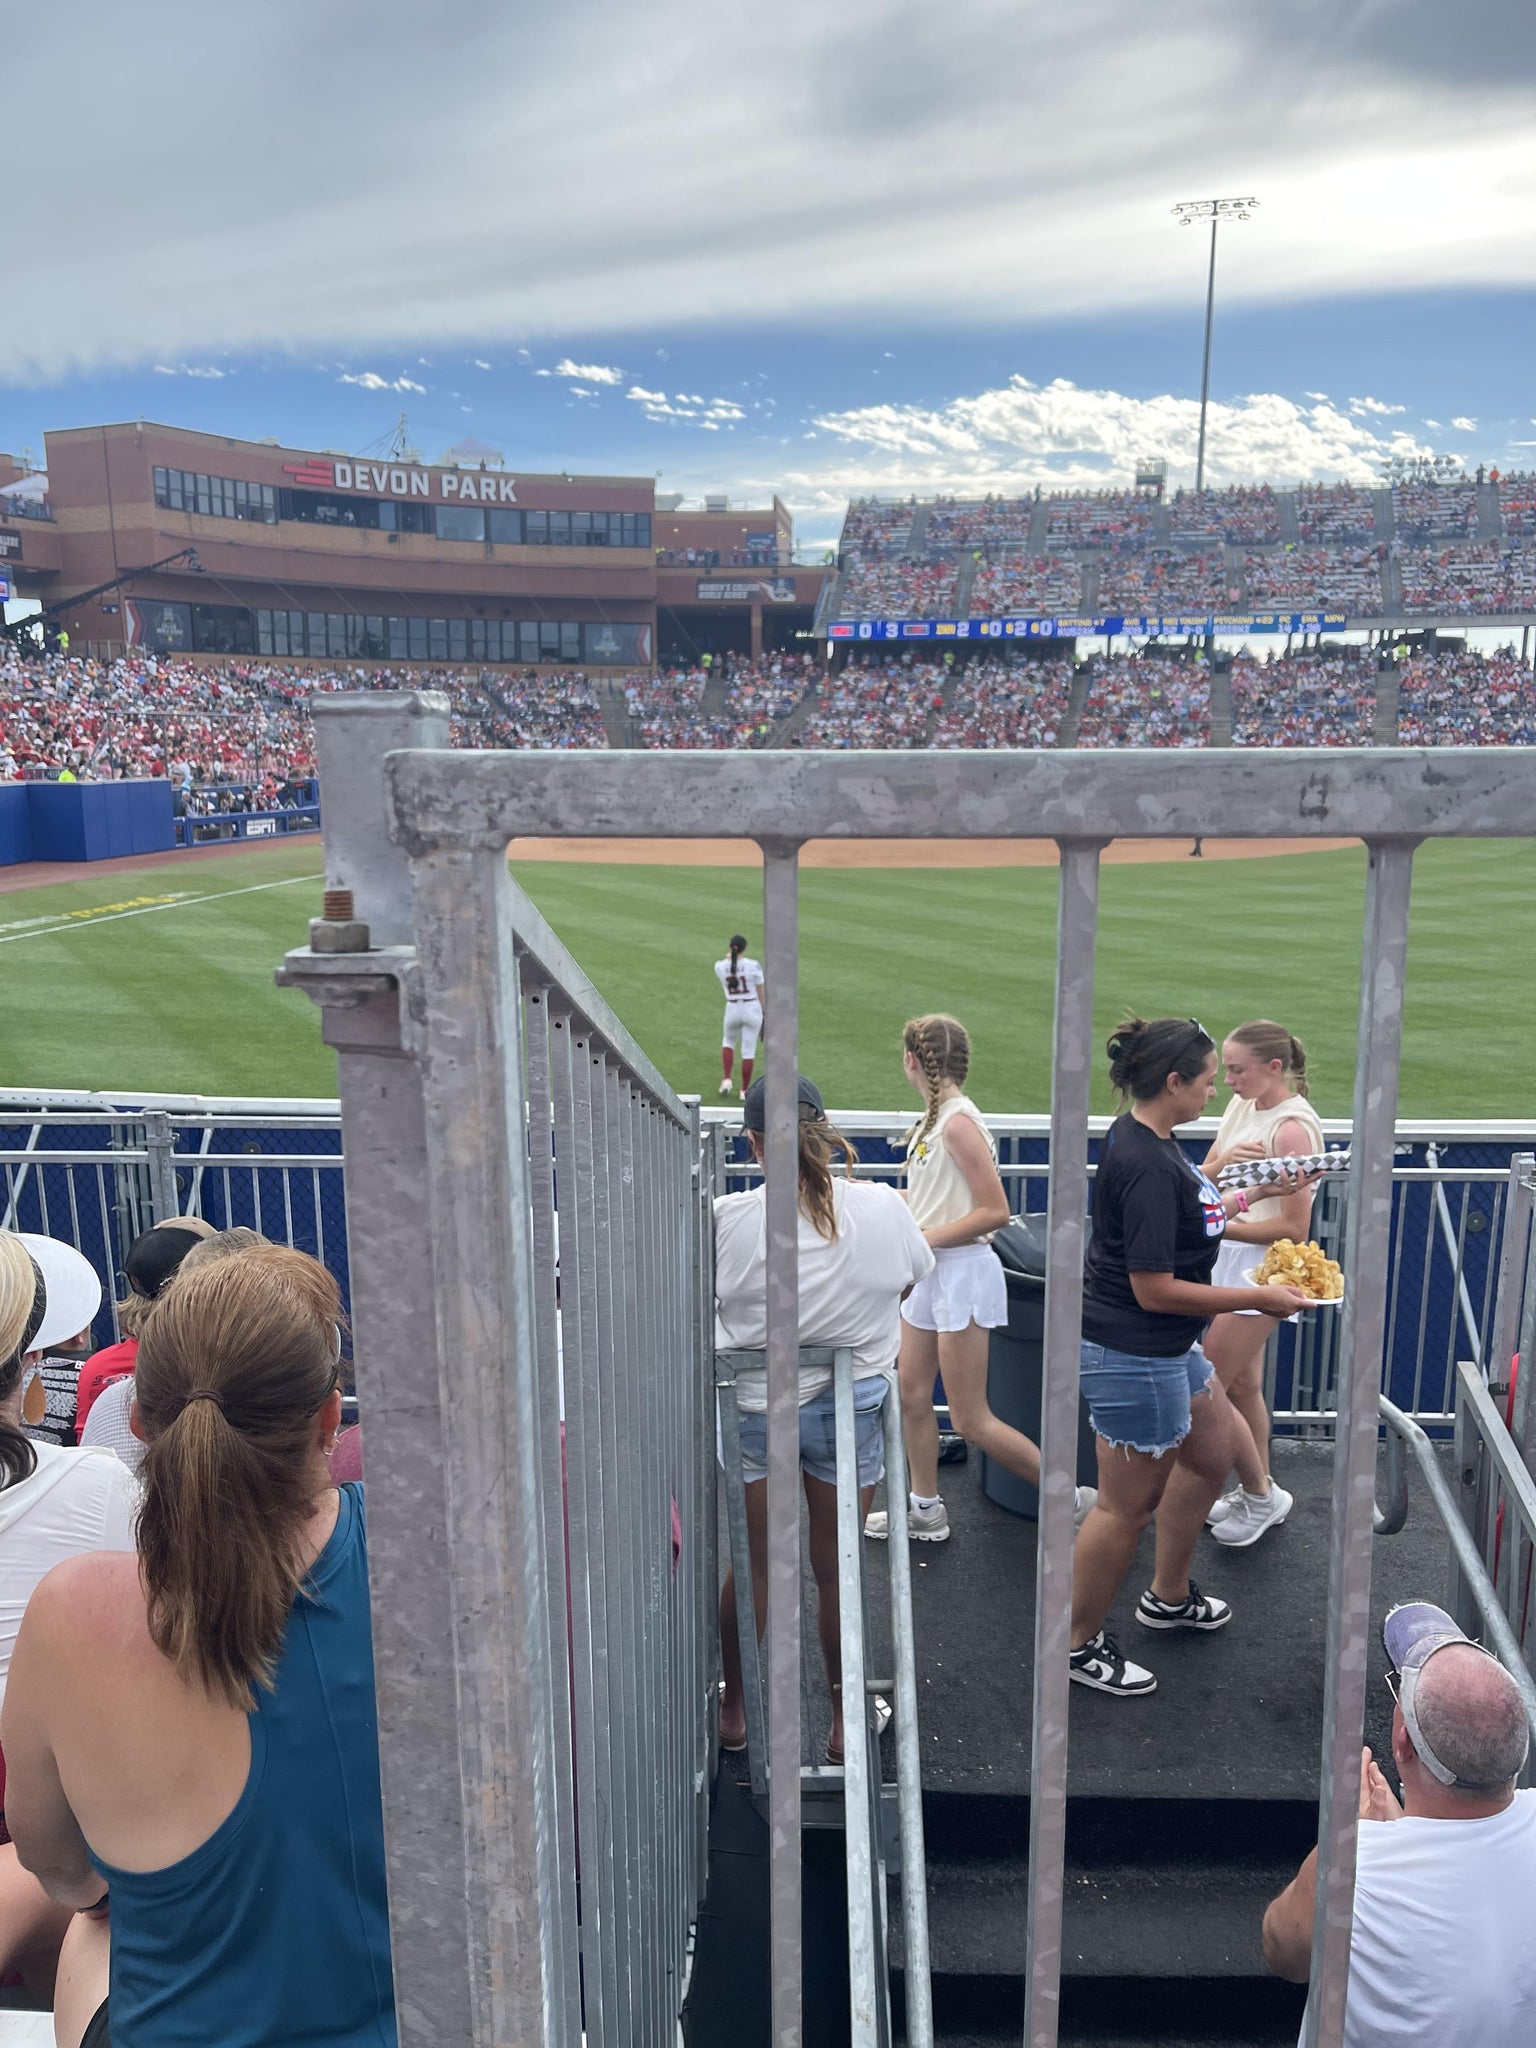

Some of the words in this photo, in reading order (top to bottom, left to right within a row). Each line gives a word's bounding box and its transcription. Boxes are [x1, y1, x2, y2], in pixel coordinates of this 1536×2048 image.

[334, 462, 430, 497] DEVON
[441, 473, 518, 503] PARK
[859, 622, 872, 638] 0
[886, 621, 899, 638] 3
[957, 620, 969, 637] 2
[990, 620, 1003, 637] 0
[1014, 620, 1028, 637] 2
[1040, 619, 1053, 636] 0
[246, 818, 276, 835] ESPN
